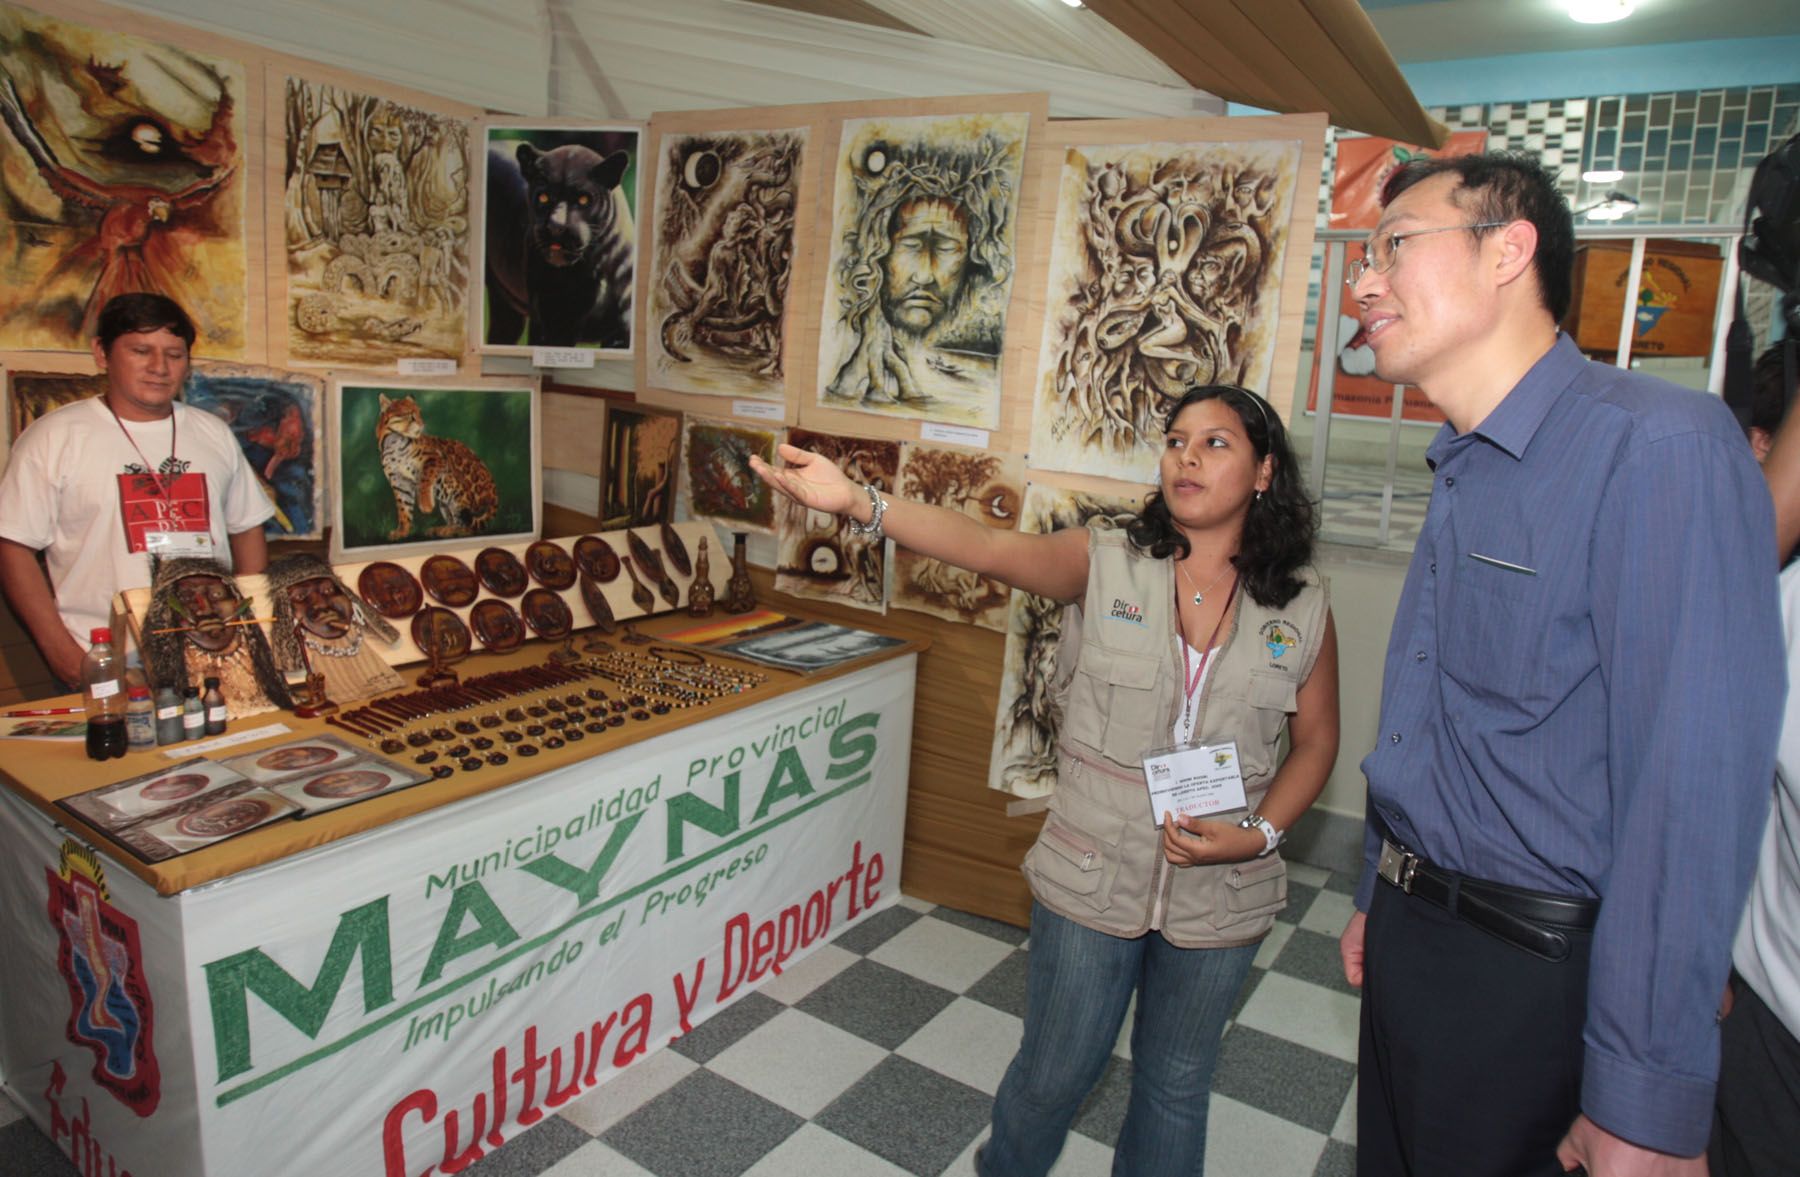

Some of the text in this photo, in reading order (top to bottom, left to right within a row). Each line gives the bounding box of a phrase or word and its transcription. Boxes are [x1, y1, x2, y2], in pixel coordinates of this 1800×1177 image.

[1331, 392, 1382, 405] mazonia
[201, 711, 882, 1086] MAYNAS
[424, 697, 847, 899] Municipalidad Provincial
[382, 840, 885, 1177] Cultura y Deporte
[402, 842, 770, 1053] Impulsando el Progreso
